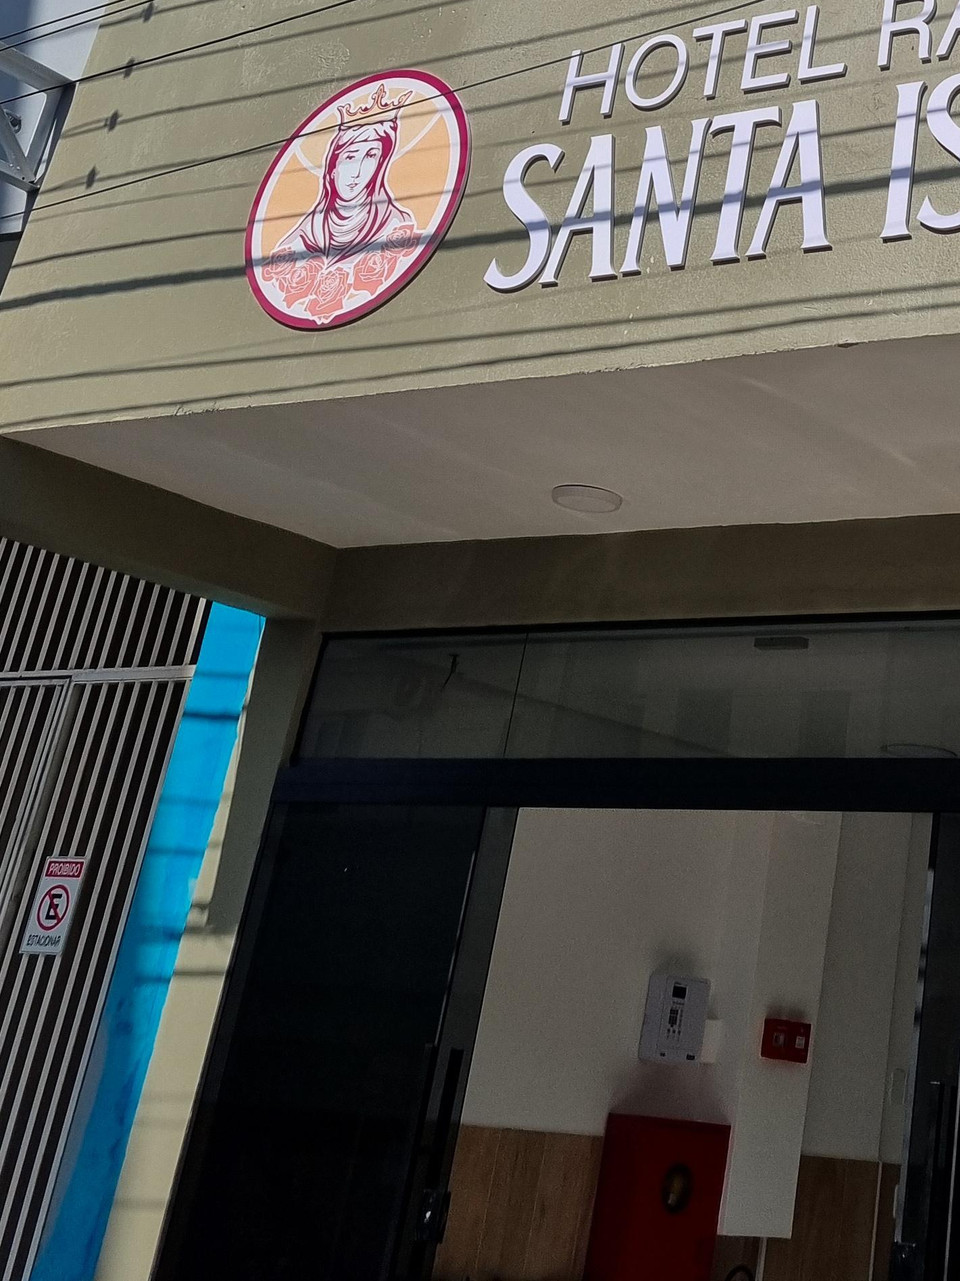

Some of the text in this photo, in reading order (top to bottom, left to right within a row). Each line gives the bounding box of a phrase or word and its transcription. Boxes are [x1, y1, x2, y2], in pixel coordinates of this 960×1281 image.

[559, 5, 847, 123] HOTEL
[483, 100, 832, 293] SANTA
[47, 862, 81, 876] PROIBIDO
